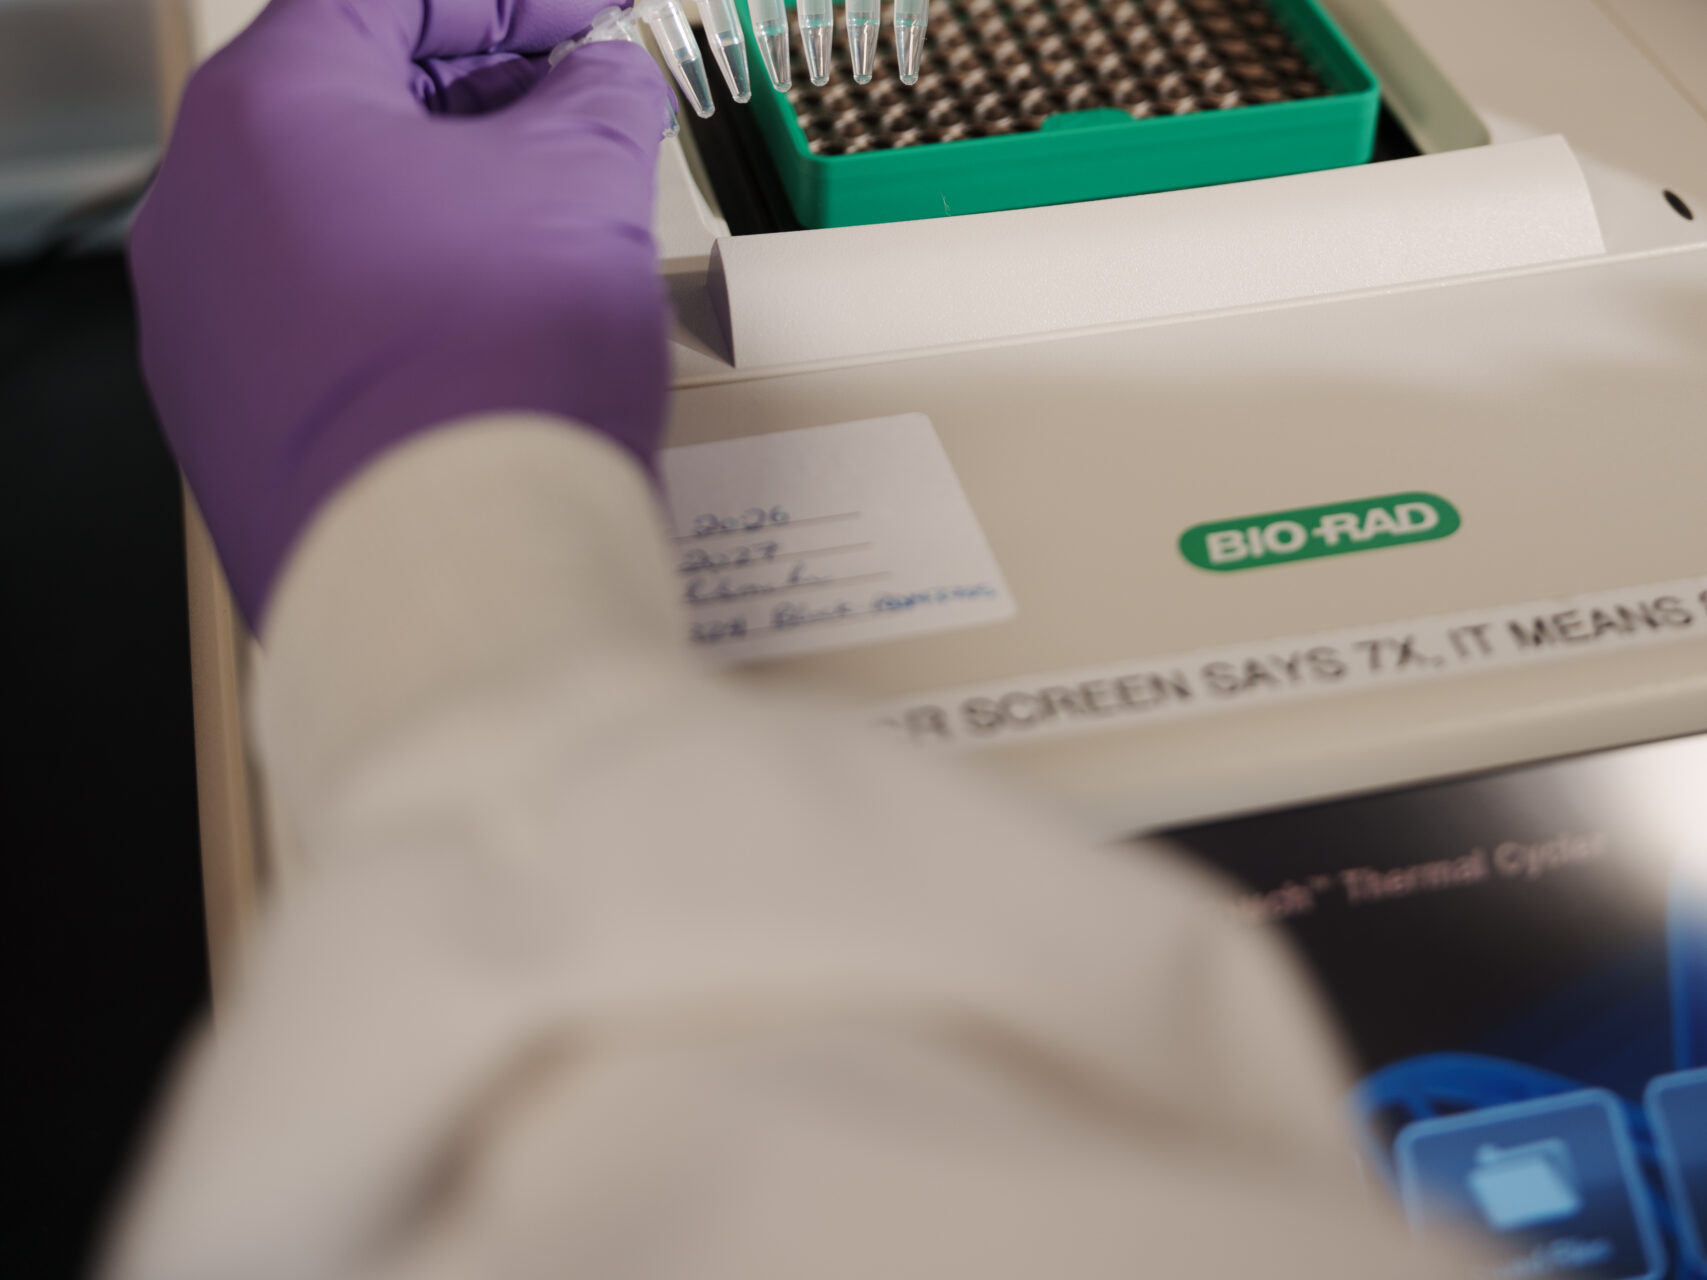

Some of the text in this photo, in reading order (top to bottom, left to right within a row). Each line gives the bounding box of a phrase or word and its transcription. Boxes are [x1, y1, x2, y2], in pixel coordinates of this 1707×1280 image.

[1204, 502, 1440, 565] BIO-RAD
[960, 668, 1193, 738] SCREEN
[1201, 646, 1348, 699] SAYS
[1447, 623, 1492, 660] IT
[1506, 595, 1694, 649] MEANS
[1341, 846, 1486, 905] Thermal
